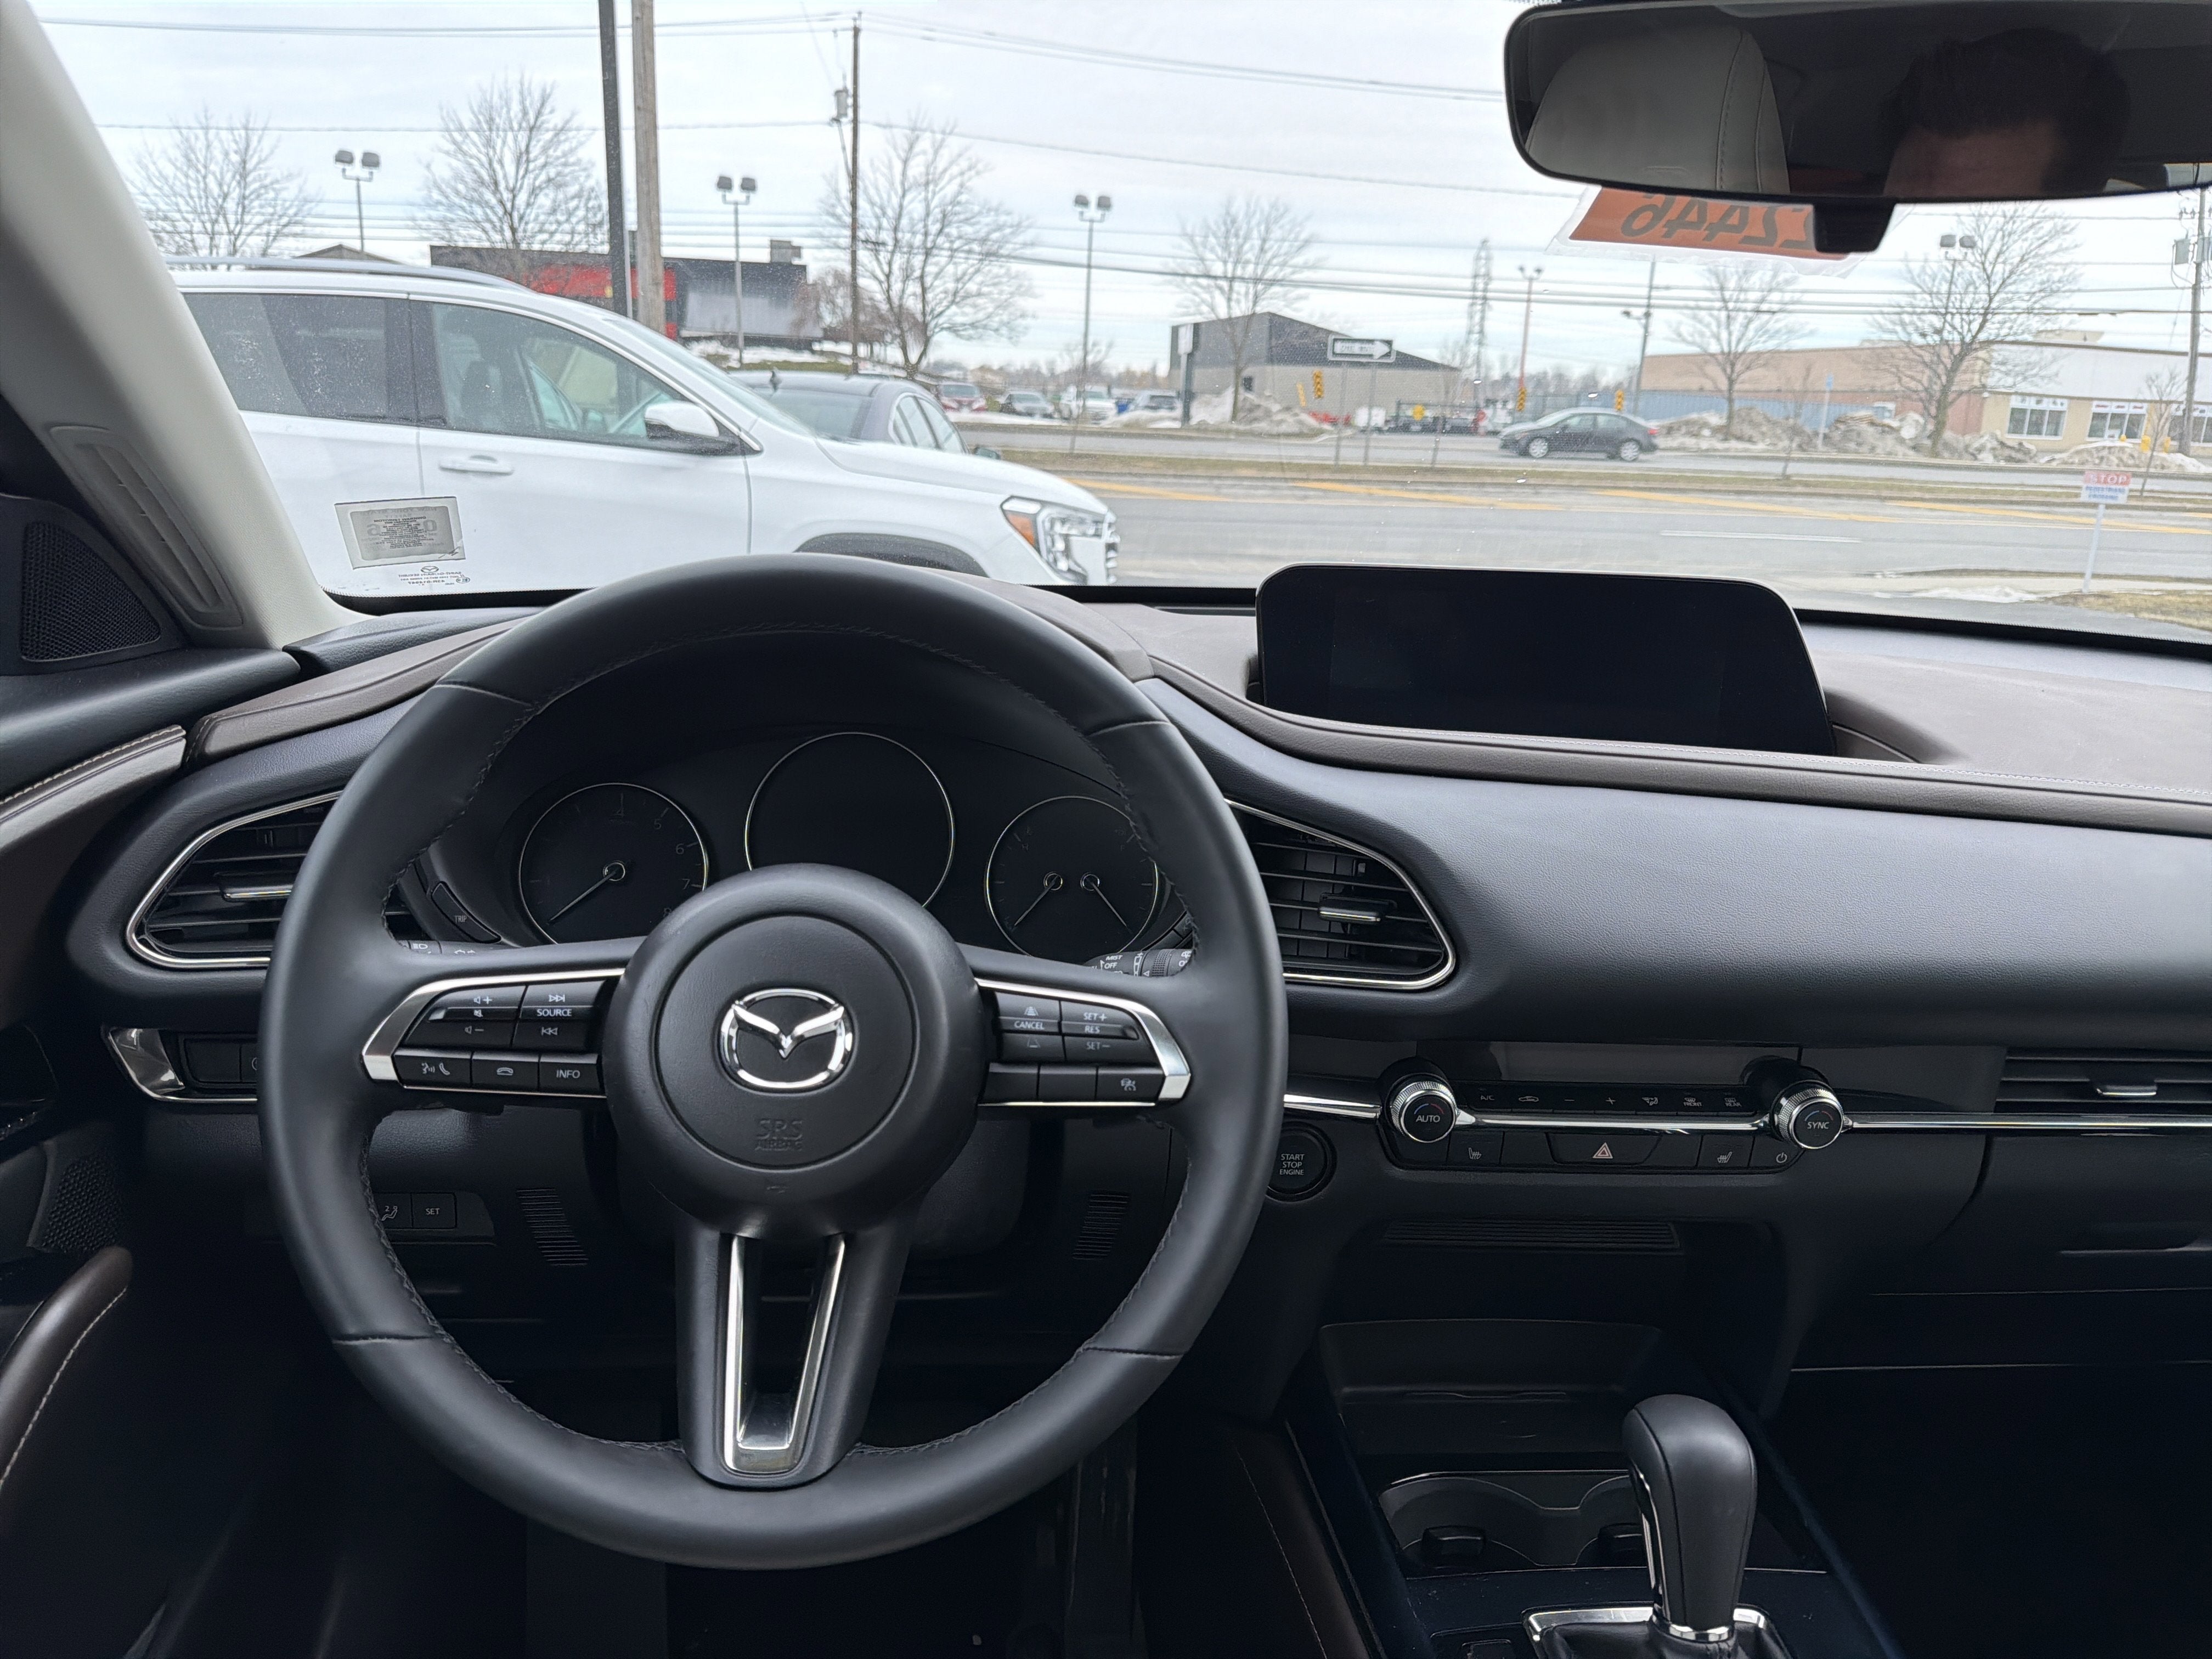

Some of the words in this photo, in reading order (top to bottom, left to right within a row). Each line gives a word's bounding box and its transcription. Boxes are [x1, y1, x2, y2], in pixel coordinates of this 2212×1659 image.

[2089, 473, 2128, 485] STOP
[653, 819, 662, 830] 5
[675, 843, 685, 855] 6
[681, 878, 690, 890] 7
[454, 915, 467, 923] TRIP
[537, 1008, 572, 1017] SOURCE
[1014, 1020, 1045, 1030] CANCEL
[1085, 1025, 1101, 1034] RES
[556, 1069, 580, 1079] INFO
[1416, 1114, 1440, 1124] AUTO
[1807, 1121, 1830, 1130] SYNC
[425, 1207, 441, 1216] SET
